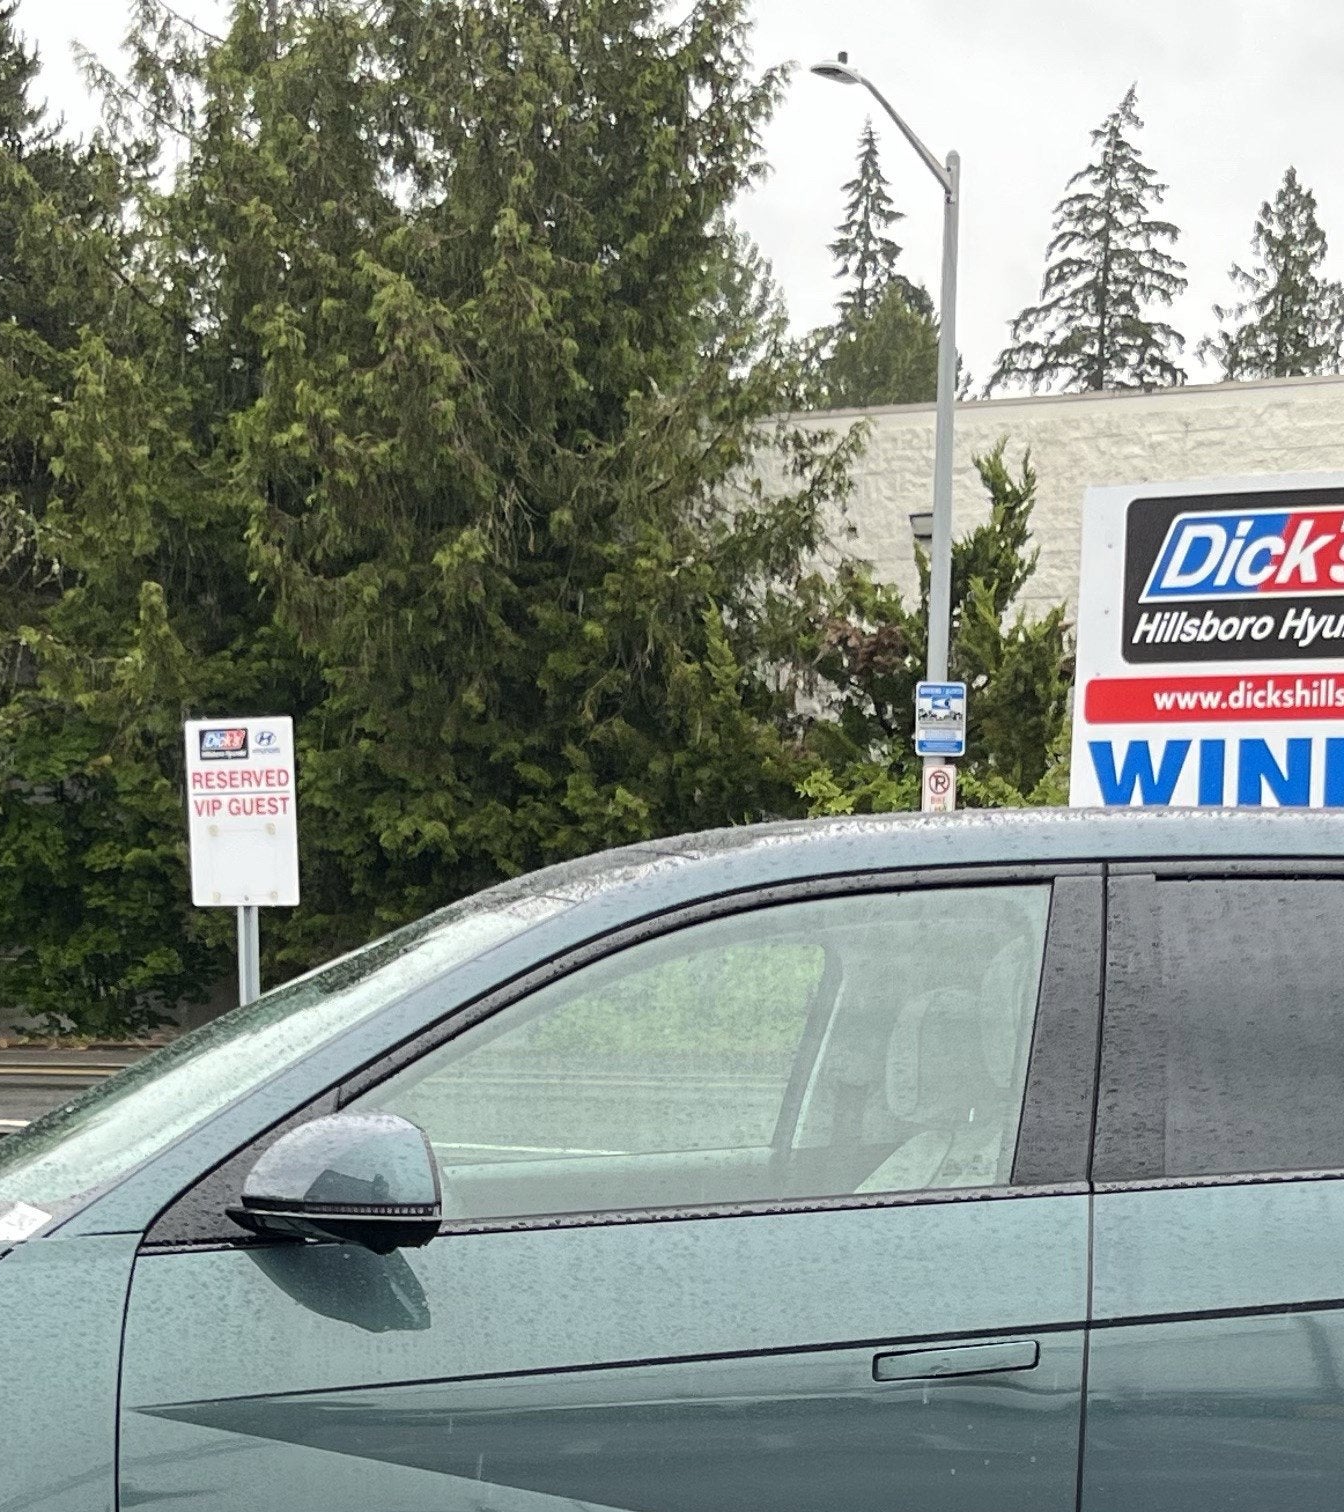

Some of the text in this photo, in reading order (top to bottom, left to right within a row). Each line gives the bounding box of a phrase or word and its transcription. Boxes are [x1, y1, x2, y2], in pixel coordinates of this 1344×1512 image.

[1131, 609, 1275, 645] Hillsboro
[191, 768, 290, 790] RESERVED
[193, 797, 290, 817] VIP GUEST
